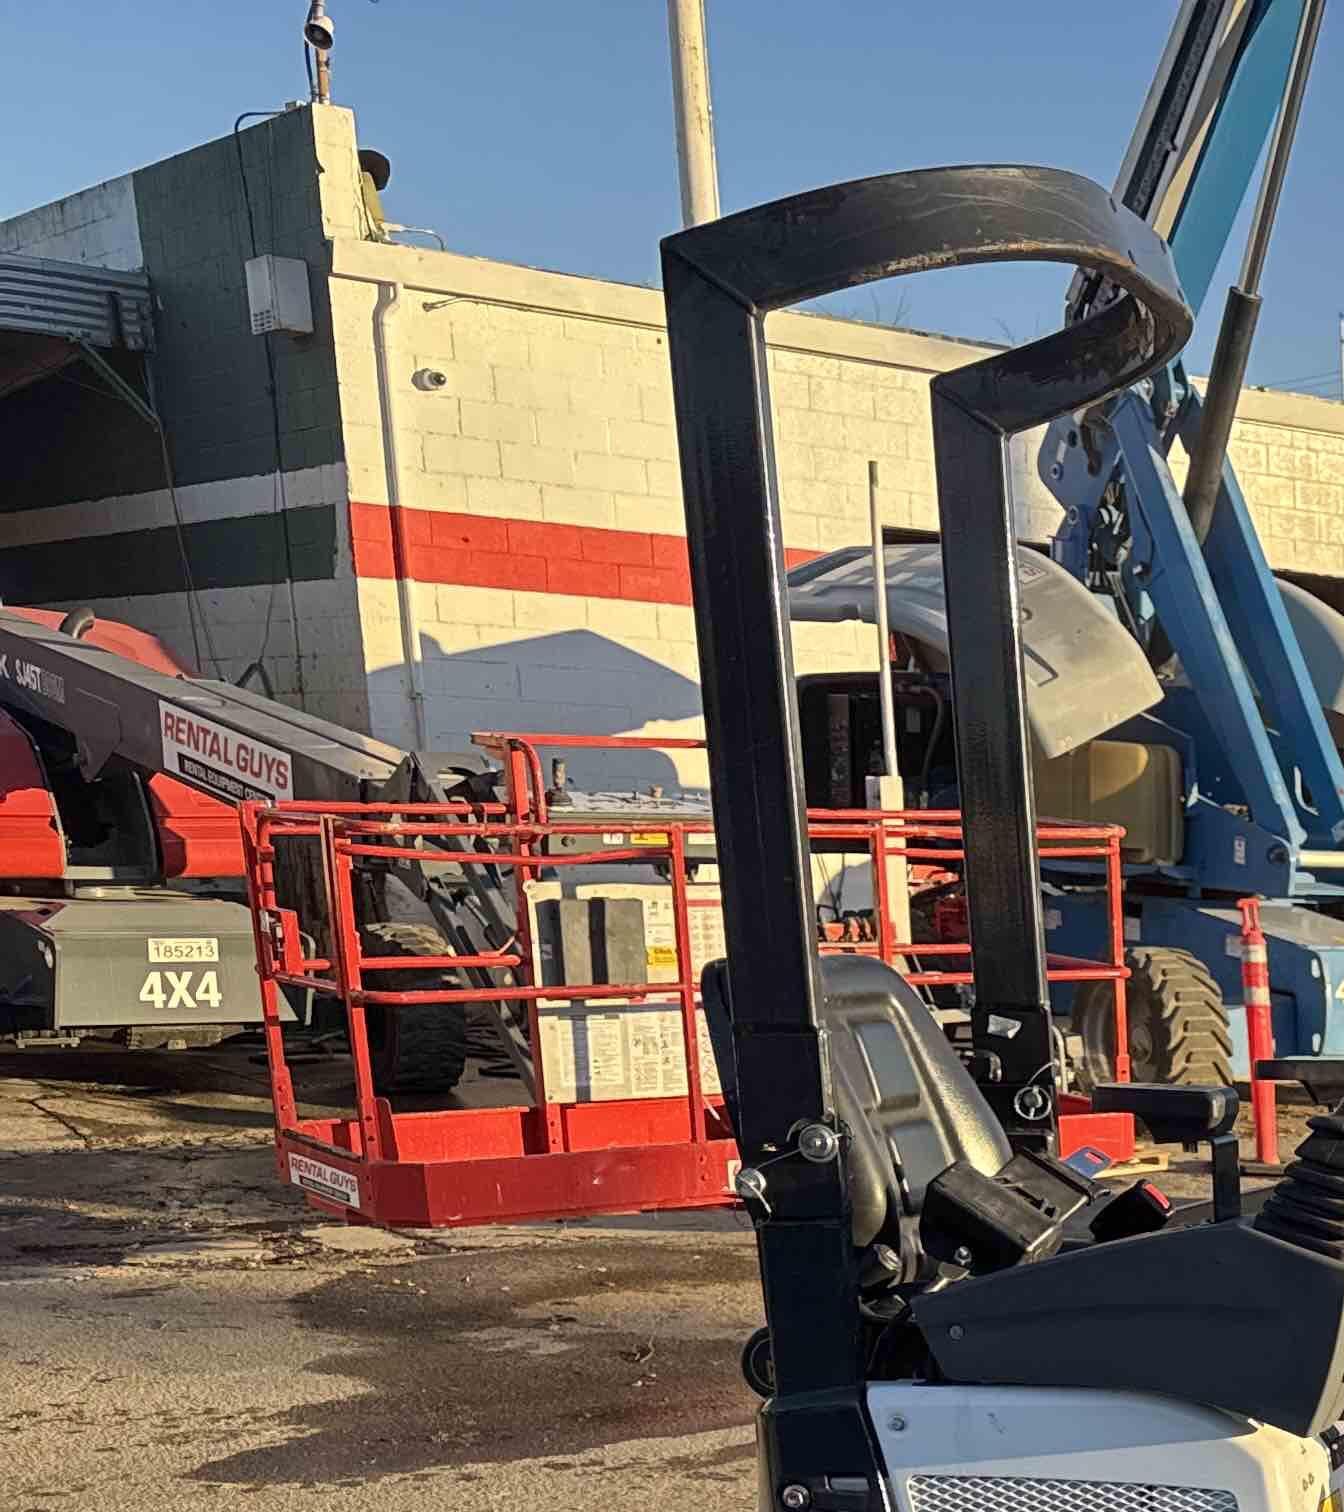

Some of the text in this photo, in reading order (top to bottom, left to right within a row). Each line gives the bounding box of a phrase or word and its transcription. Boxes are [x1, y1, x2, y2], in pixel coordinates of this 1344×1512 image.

[163, 711, 289, 790] RENTAL GUYS
[153, 945, 215, 959] 185213
[139, 970, 223, 1009] 4X4
[291, 1158, 328, 1182] RENTAL
[329, 1171, 357, 1192] GUYS
